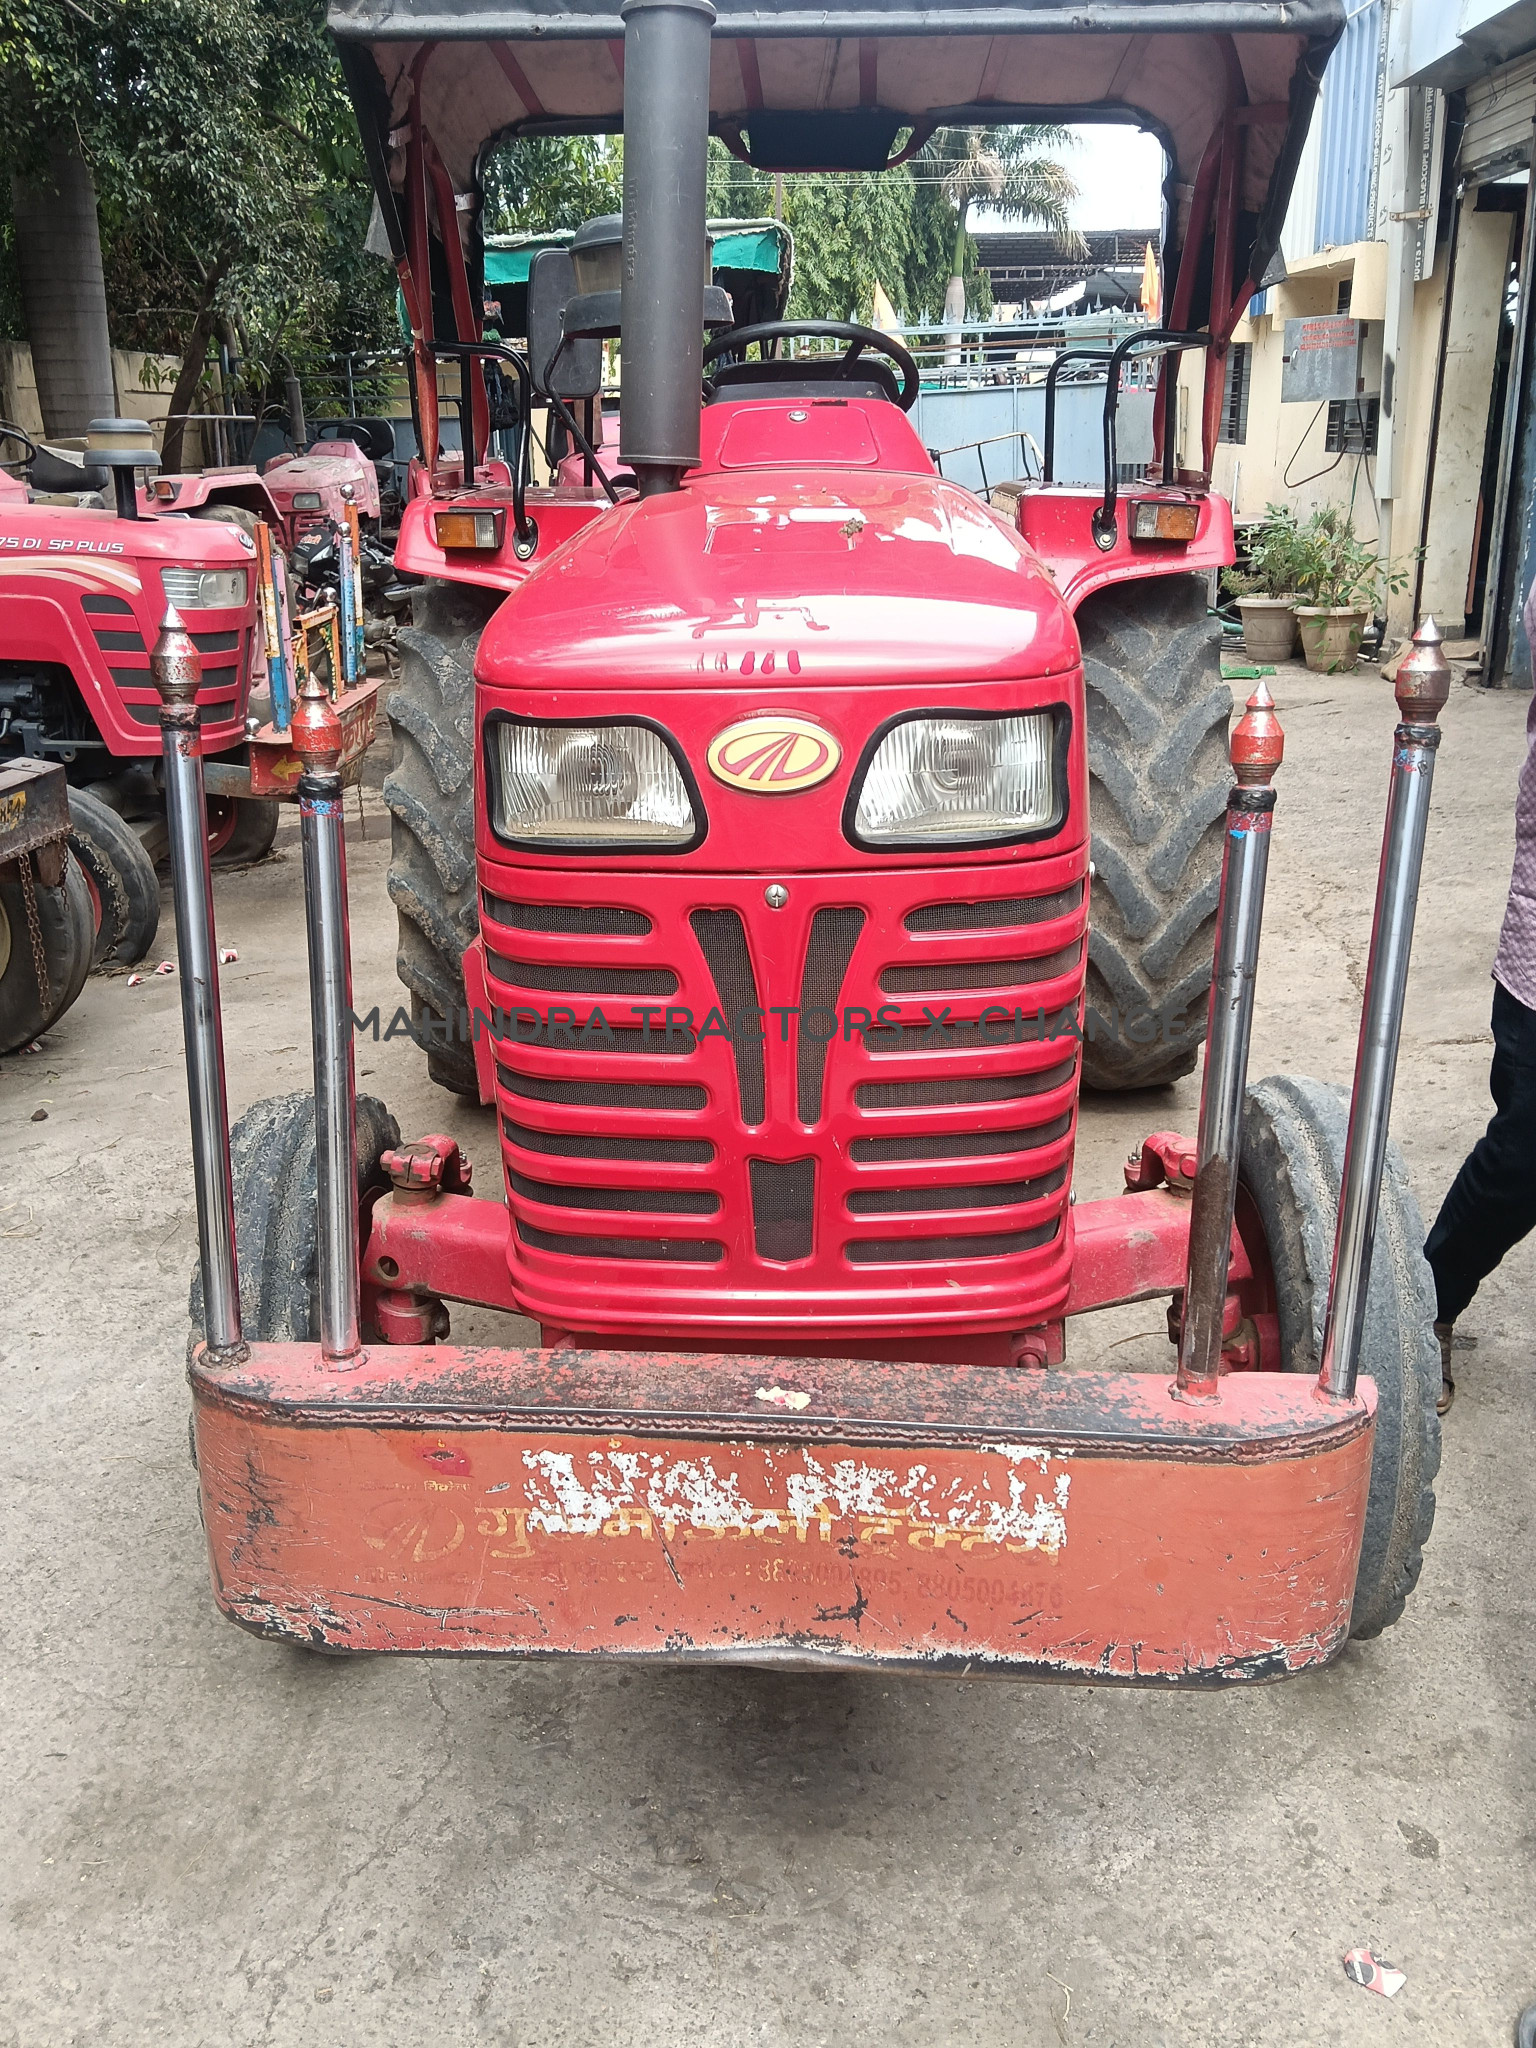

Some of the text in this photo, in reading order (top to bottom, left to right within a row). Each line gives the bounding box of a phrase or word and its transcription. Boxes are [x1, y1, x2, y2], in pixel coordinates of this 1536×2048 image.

[1423, 106, 1433, 150] BUILDING
[1367, 190, 1377, 239] PRODUCTS
[22, 537, 43, 549] DI
[47, 539, 74, 551] SP
[76, 540, 125, 554] PLUS
